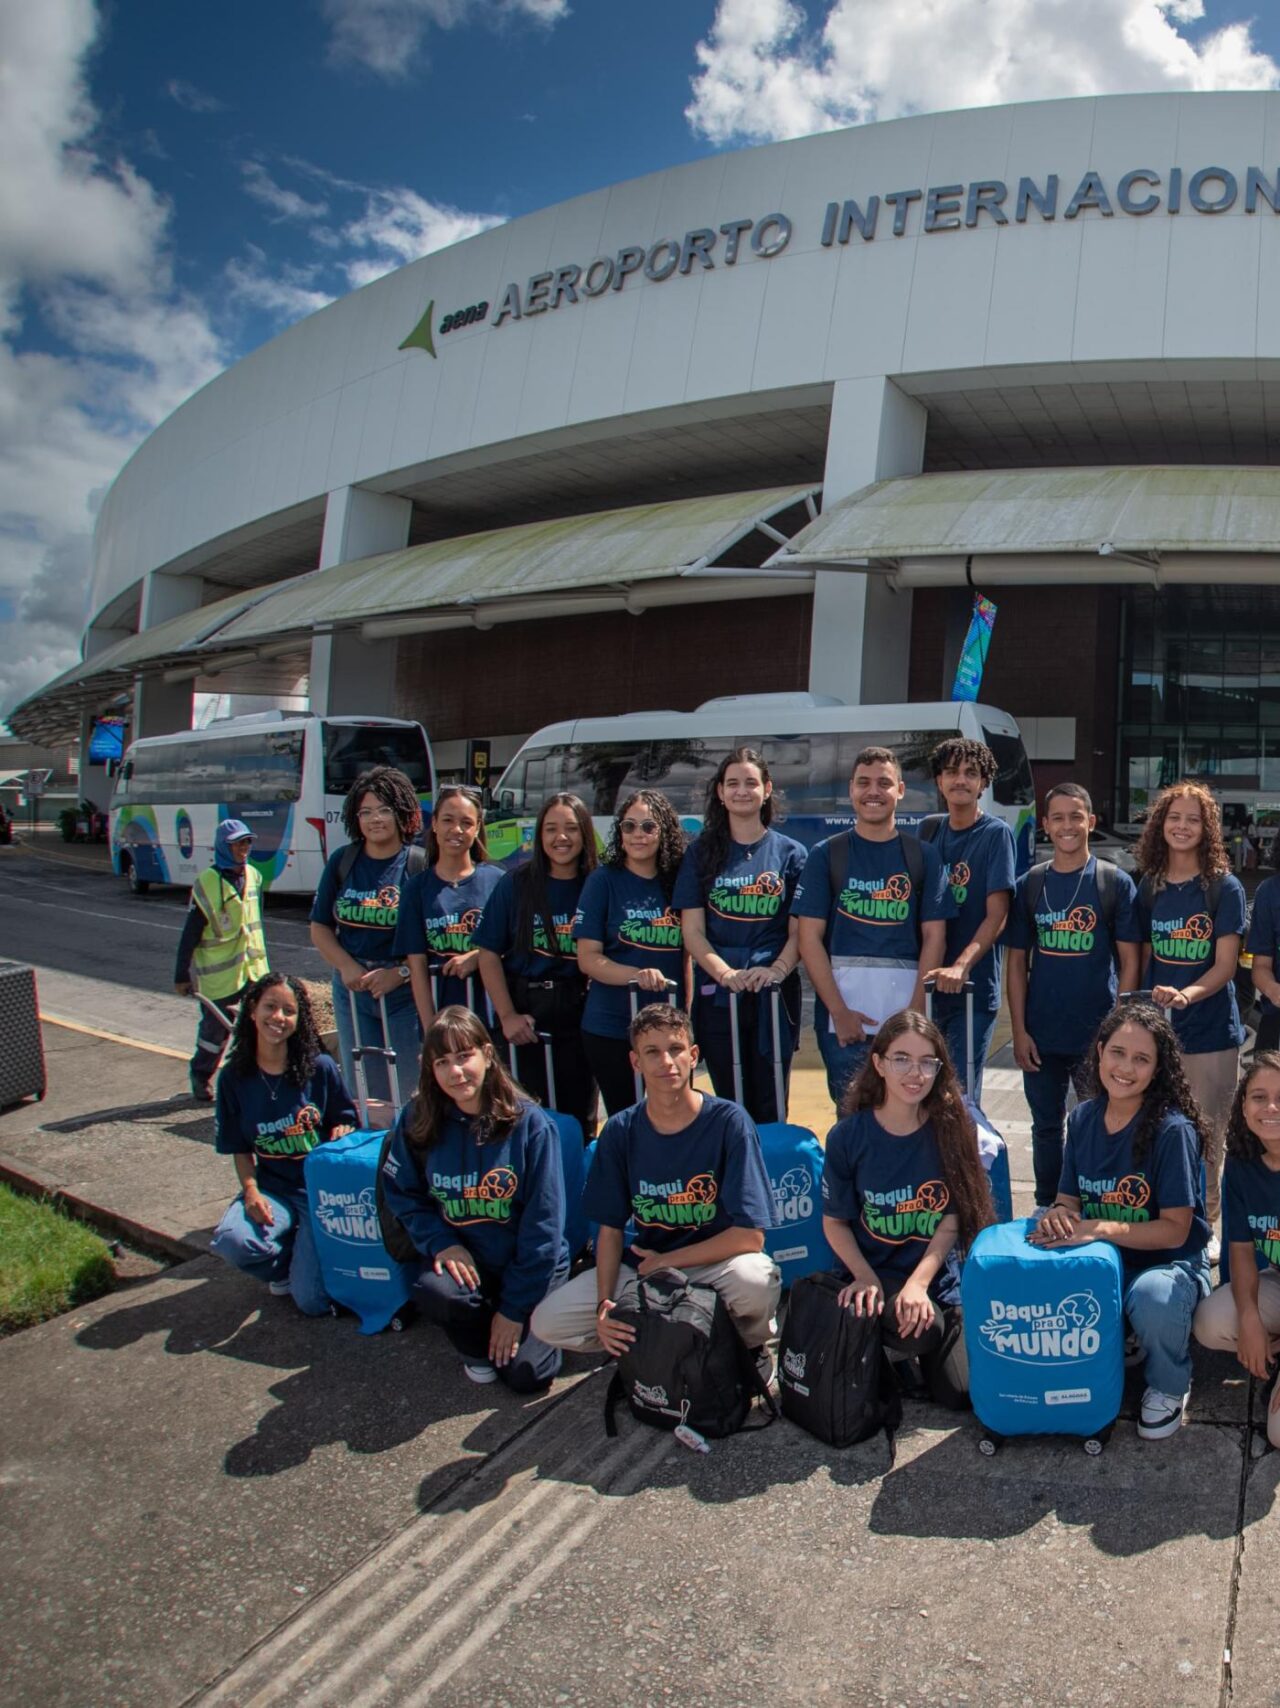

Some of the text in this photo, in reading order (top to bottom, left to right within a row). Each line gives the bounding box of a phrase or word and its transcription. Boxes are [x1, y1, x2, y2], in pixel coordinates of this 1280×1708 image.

[491, 212, 791, 326] AEROPORTO
[439, 300, 489, 334] aena
[715, 874, 754, 890] Daqui
[849, 877, 884, 893] Daqui
[344, 888, 376, 902] Daqui
[425, 913, 459, 929] Daqui
[627, 907, 662, 921] Daqui
[1151, 917, 1183, 933] Daqui
[256, 1114, 294, 1135] Daqui
[432, 1171, 478, 1192] Daqui
[639, 1179, 682, 1198] Daqui
[1078, 1174, 1117, 1195] Daqui
[318, 1189, 355, 1208] Daqui
[864, 1185, 913, 1207] Daqui
[1248, 1215, 1278, 1232] aqui
[991, 1300, 1051, 1323] Daqui
[1034, 1318, 1065, 1330] pra O
